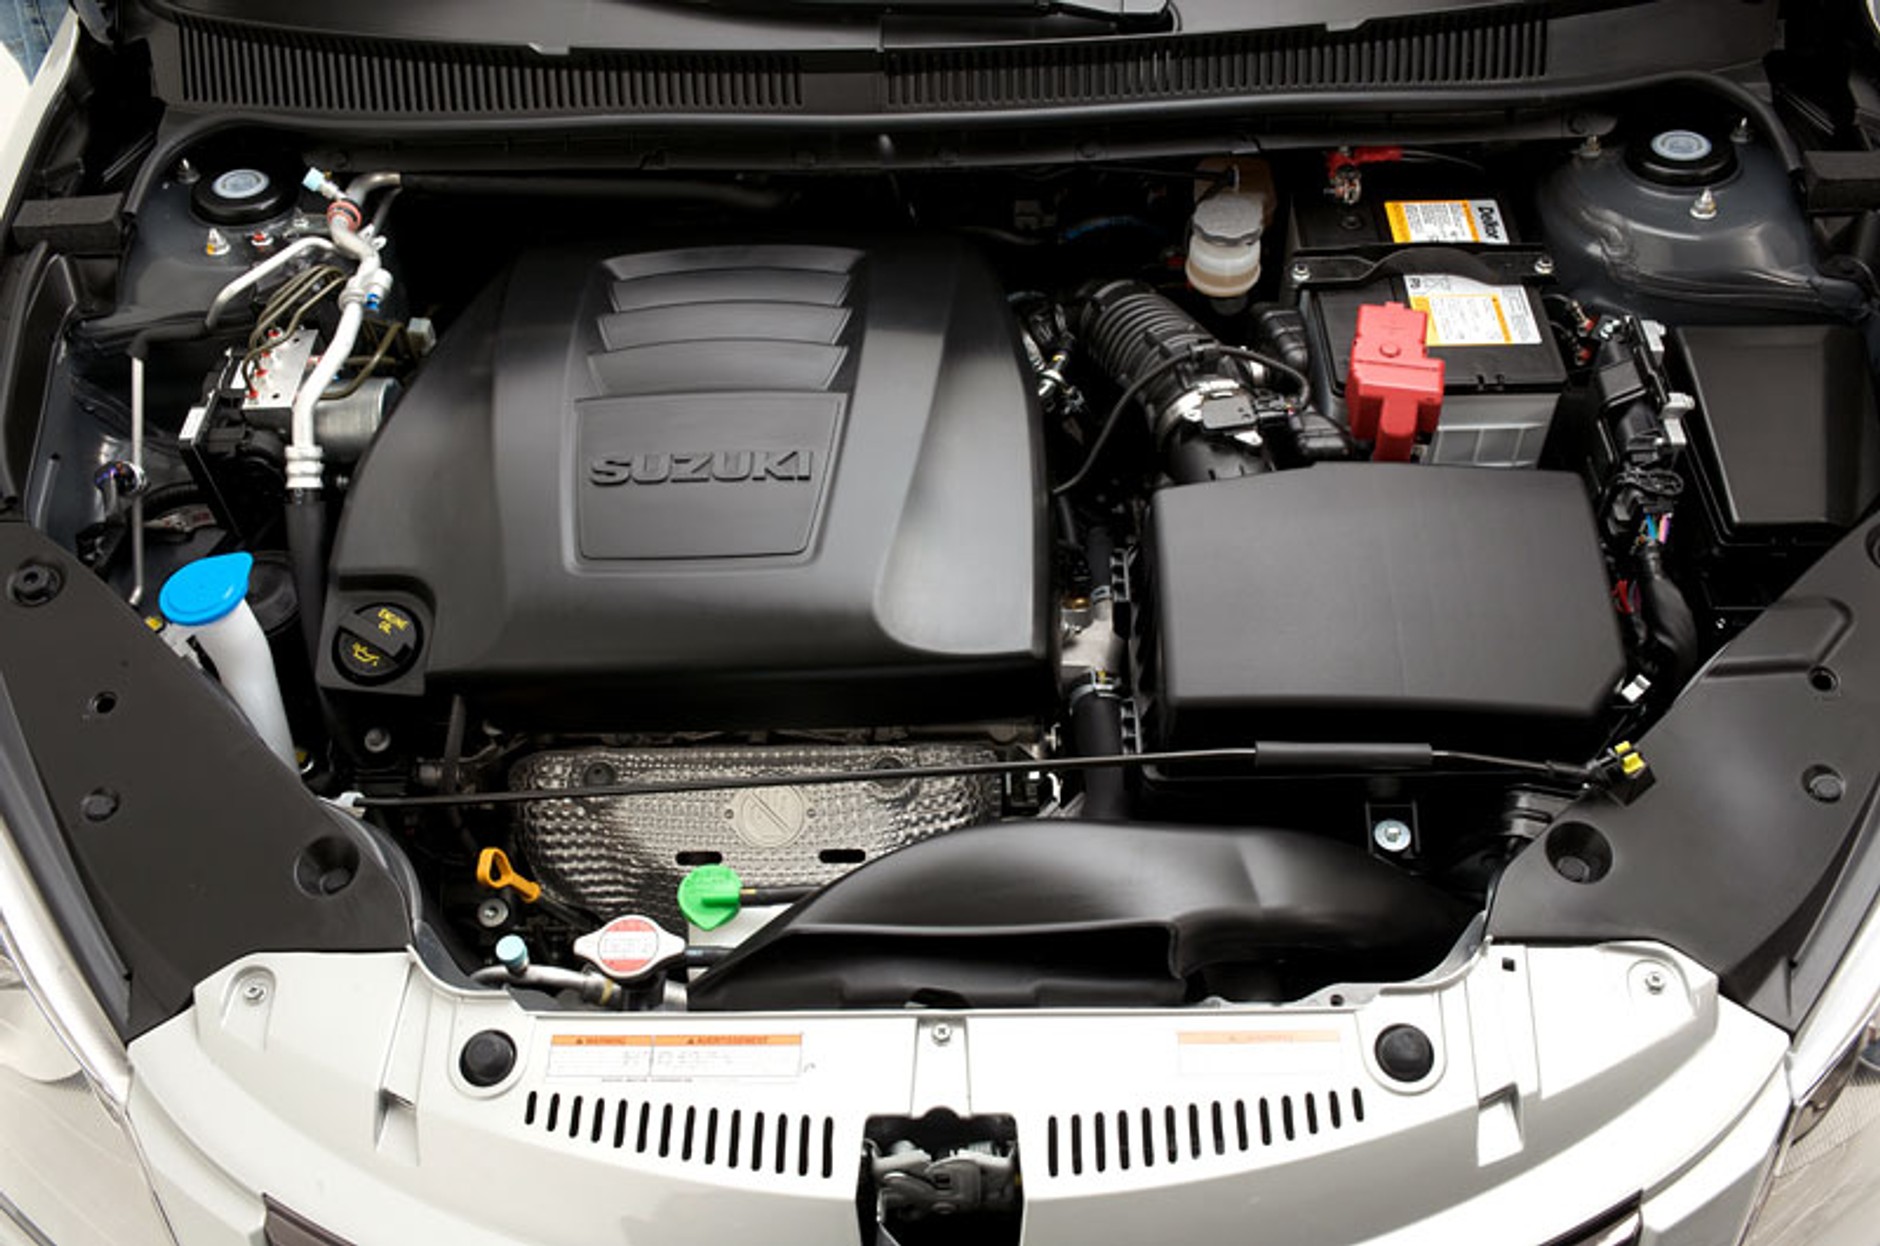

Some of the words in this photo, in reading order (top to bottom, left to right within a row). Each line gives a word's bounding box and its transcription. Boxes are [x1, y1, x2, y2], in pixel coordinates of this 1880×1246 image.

[590, 450, 815, 486] SUZUKI
[378, 608, 409, 630] ENGINE
[378, 620, 392, 635] OIL
